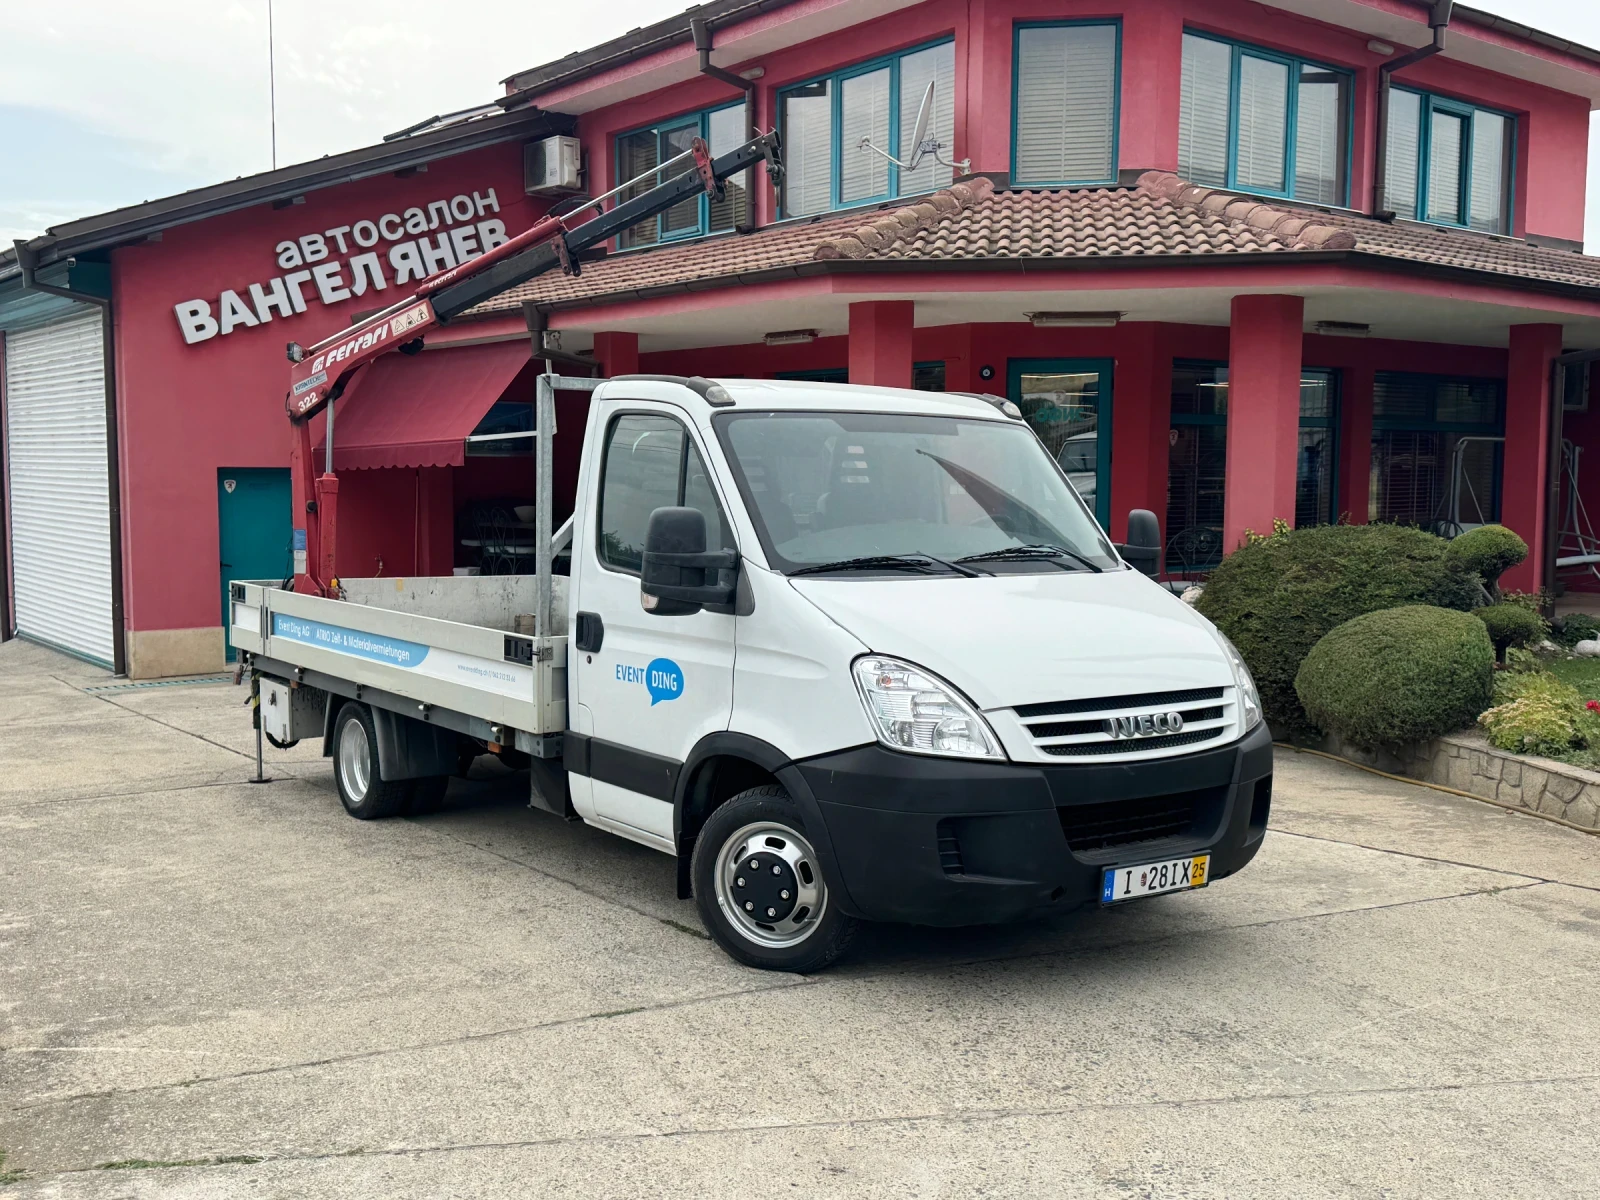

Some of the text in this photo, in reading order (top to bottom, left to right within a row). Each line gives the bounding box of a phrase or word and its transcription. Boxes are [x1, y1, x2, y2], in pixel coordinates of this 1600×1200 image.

[276, 187, 500, 269] автосалон
[174, 218, 510, 344] ВАНГЕЛ ЯНЕВ
[298, 392, 319, 411] 322
[290, 621, 301, 637] Ding
[302, 625, 310, 637] AG
[348, 635, 410, 662] Materialvermietungen
[616, 663, 678, 692] EVENT DING
[1108, 711, 1184, 739] IVECO
[1192, 862, 1206, 879] 25
